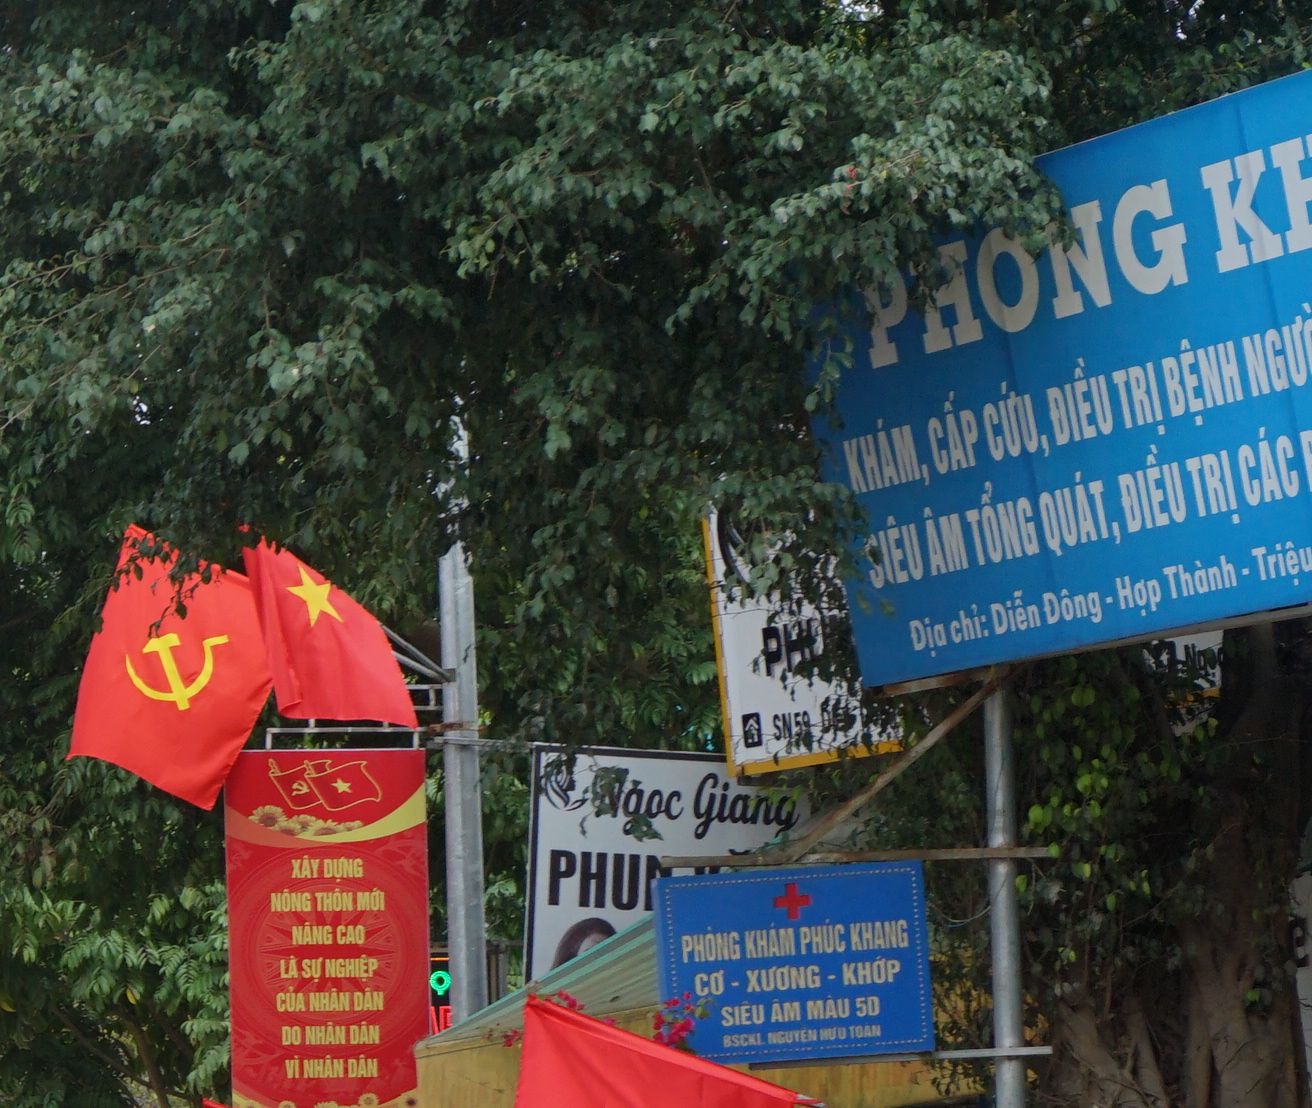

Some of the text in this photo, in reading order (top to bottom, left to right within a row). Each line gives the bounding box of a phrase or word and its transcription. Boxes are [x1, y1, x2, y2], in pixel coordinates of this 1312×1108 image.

[843, 424, 929, 495] KHÁM,
[928, 390, 978, 475] CẤP
[984, 381, 1049, 463] CỨU,
[1047, 355, 1113, 447] ĐIỀU
[1114, 366, 1166, 434] TRỊ
[1165, 338, 1242, 427] BỆNH
[929, 506, 969, 577] ÂM
[965, 481, 1039, 566] TỔNG
[1040, 471, 1121, 559] QUÁT,
[1120, 440, 1186, 533] ĐIỀU
[1186, 450, 1239, 526] TRỊ
[1238, 427, 1300, 507] CÁC
[909, 618, 950, 658] Địa
[951, 605, 988, 645] chỉ:
[993, 590, 1040, 636] Diễn
[1042, 583, 1102, 630] Đông
[1115, 573, 1162, 621] Hợp
[1164, 554, 1238, 597] Thành
[693, 773, 800, 839] Giang
[291, 855, 364, 882] XÂY DỰNG
[271, 887, 385, 912] NÔNG THÔN MỚI
[292, 922, 366, 945] NÂNG CAO
[681, 918, 909, 963] PHÒNG KHÁM PHÚC KHANG
[280, 954, 379, 982] LÀ SỰ NGHIỆP
[694, 970, 725, 997] CƠ
[746, 965, 821, 993] XƯƠNG
[842, 955, 901, 986] KHỚP
[276, 986, 384, 1012] CỦA NHÂN DÂN
[721, 994, 880, 1027] SIÊU ÂM MÀU 5D
[281, 1021, 380, 1045] DO NHÂN DÂN
[285, 1054, 378, 1078] VÌ NHÂN DÂN
